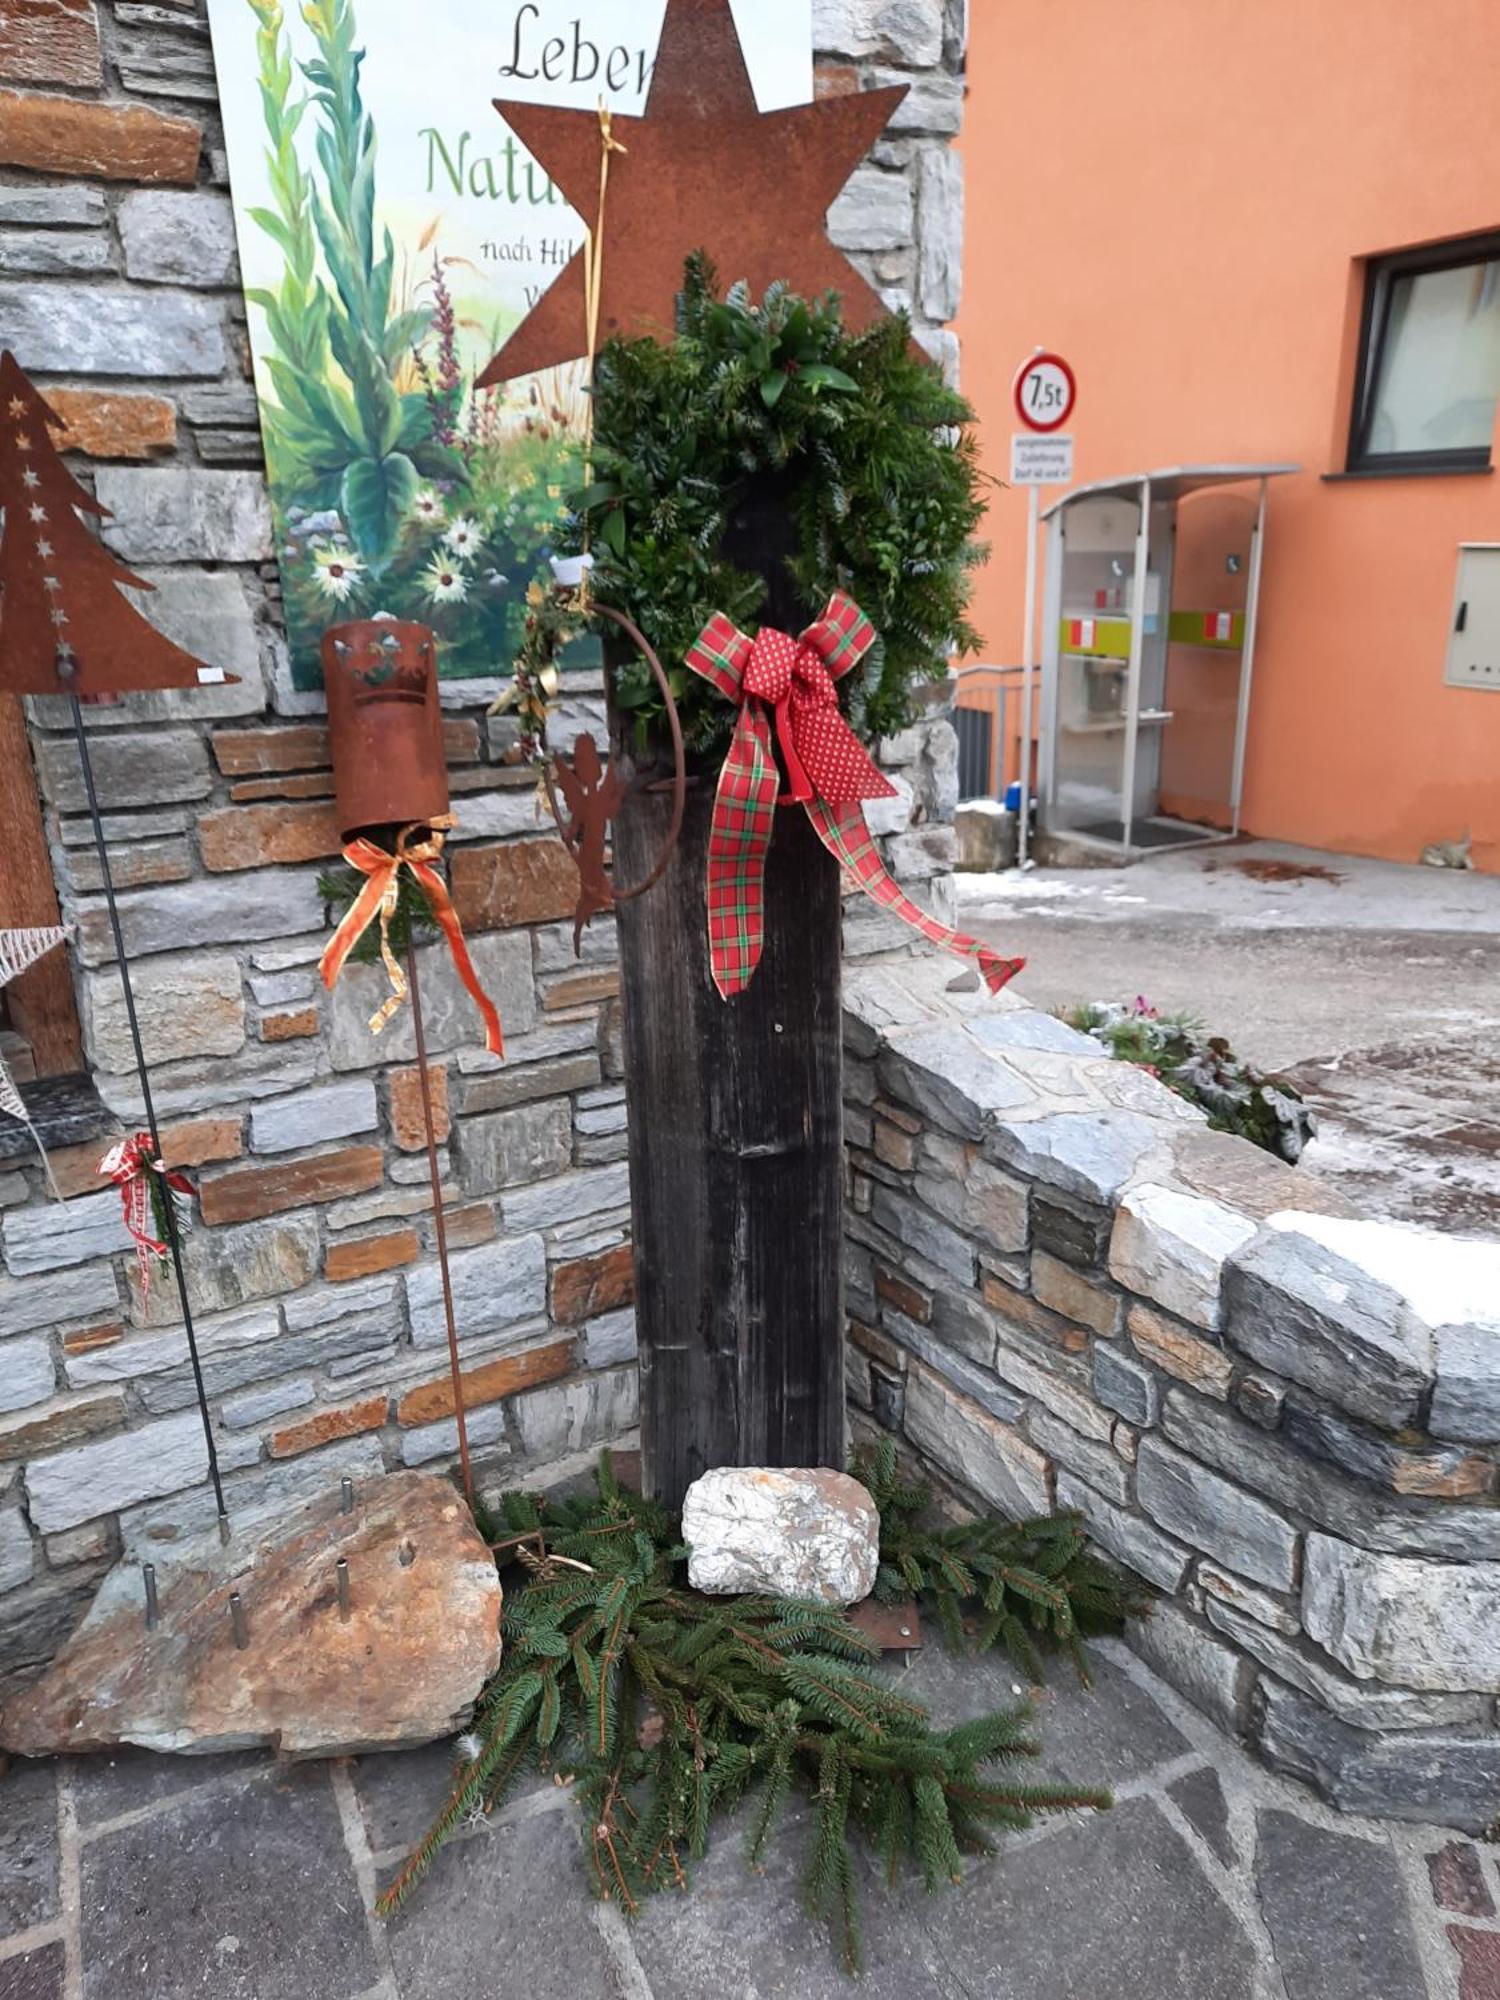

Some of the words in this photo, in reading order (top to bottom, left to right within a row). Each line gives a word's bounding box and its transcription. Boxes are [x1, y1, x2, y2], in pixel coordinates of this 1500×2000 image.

[418, 128, 569, 206] Natu
[480, 235, 532, 262] nach
[540, 237, 576, 265] Hil
